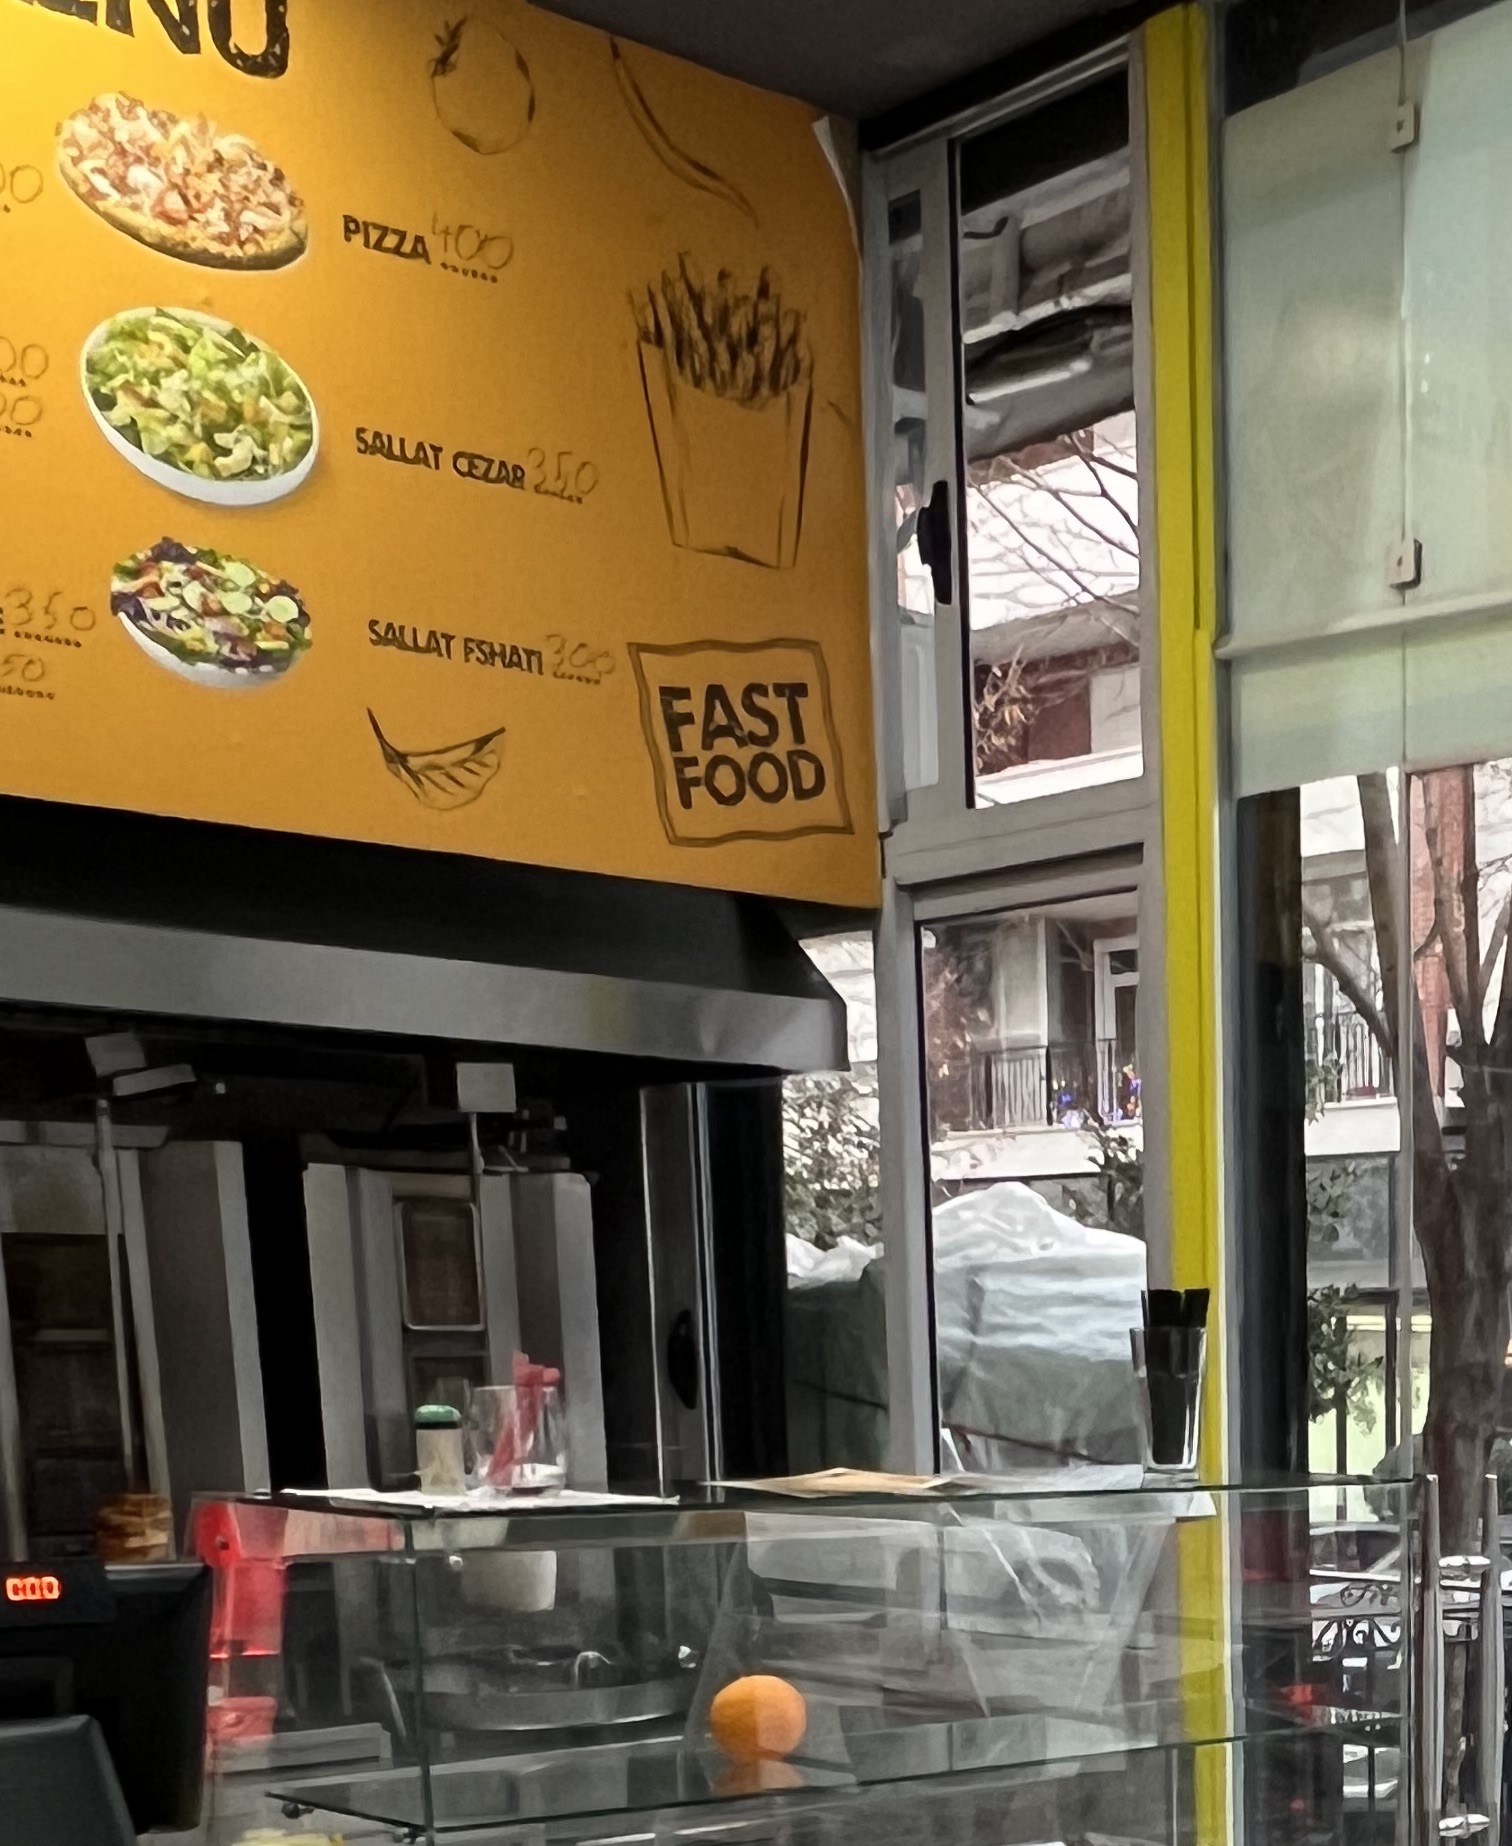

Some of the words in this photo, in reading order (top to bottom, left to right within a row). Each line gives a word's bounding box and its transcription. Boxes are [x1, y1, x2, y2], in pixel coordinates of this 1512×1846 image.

[342, 214, 432, 265] PIZZA
[356, 427, 443, 470] SALLAT
[368, 619, 455, 660] SALLAT
[463, 637, 544, 676] FSHATI
[659, 682, 808, 751] FAST
[673, 749, 826, 809] FOOD
